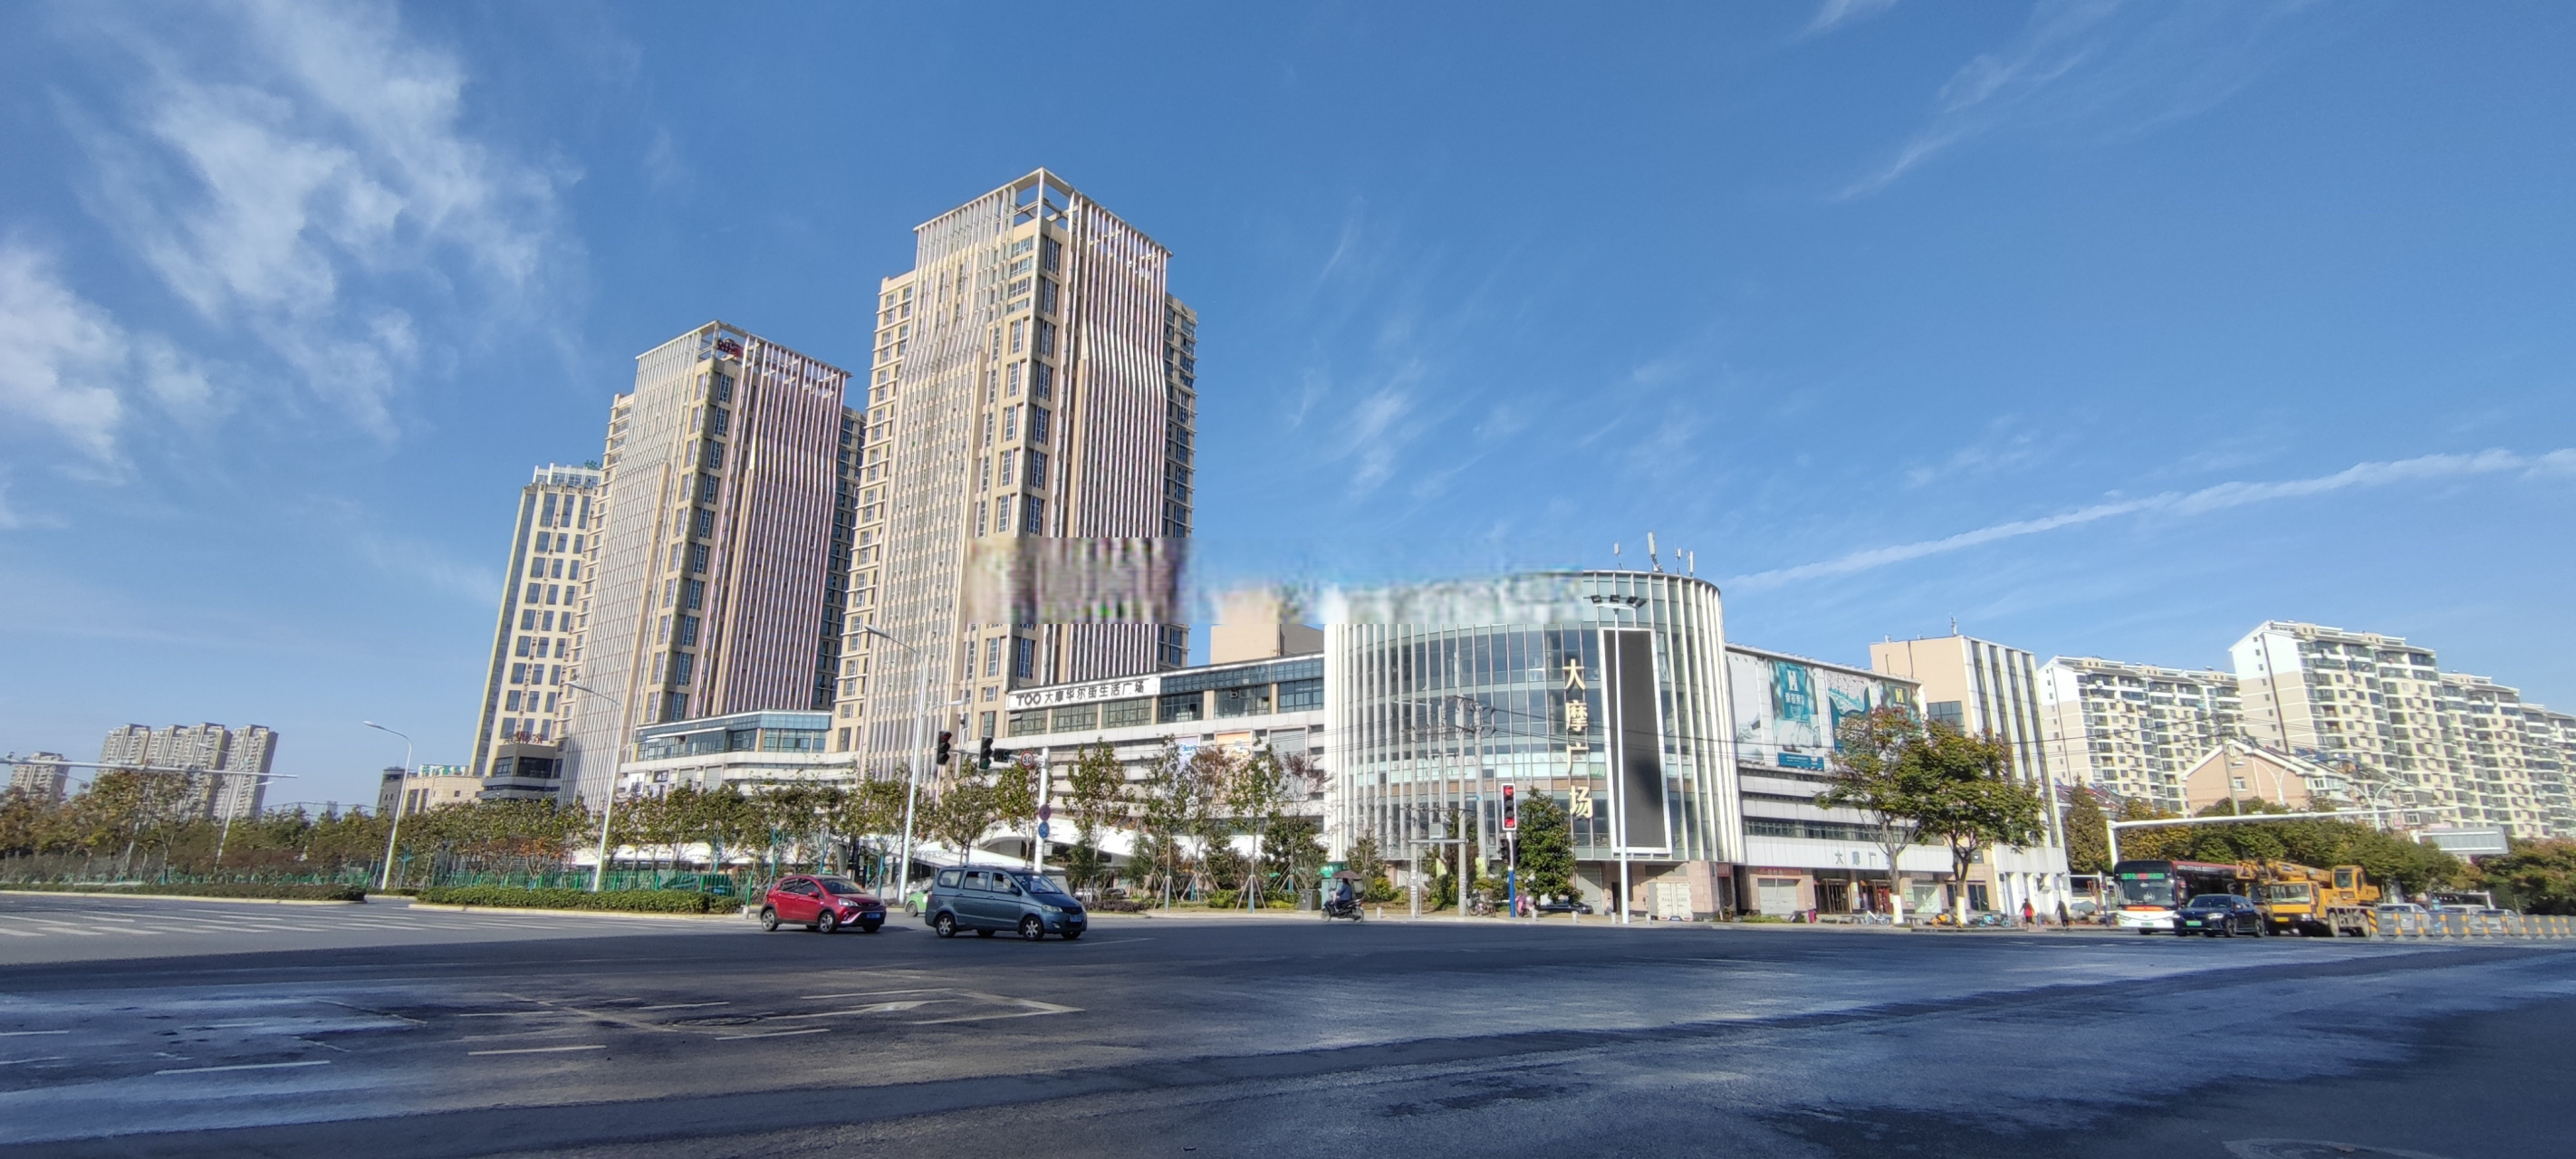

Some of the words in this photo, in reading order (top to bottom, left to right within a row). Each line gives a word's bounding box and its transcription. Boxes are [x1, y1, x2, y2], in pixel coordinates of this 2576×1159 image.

[1044, 680, 1145, 704] 大摩华尔街生活广场
[1562, 658, 1593, 819] 大摩广场
[1024, 755, 1032, 763] 50
